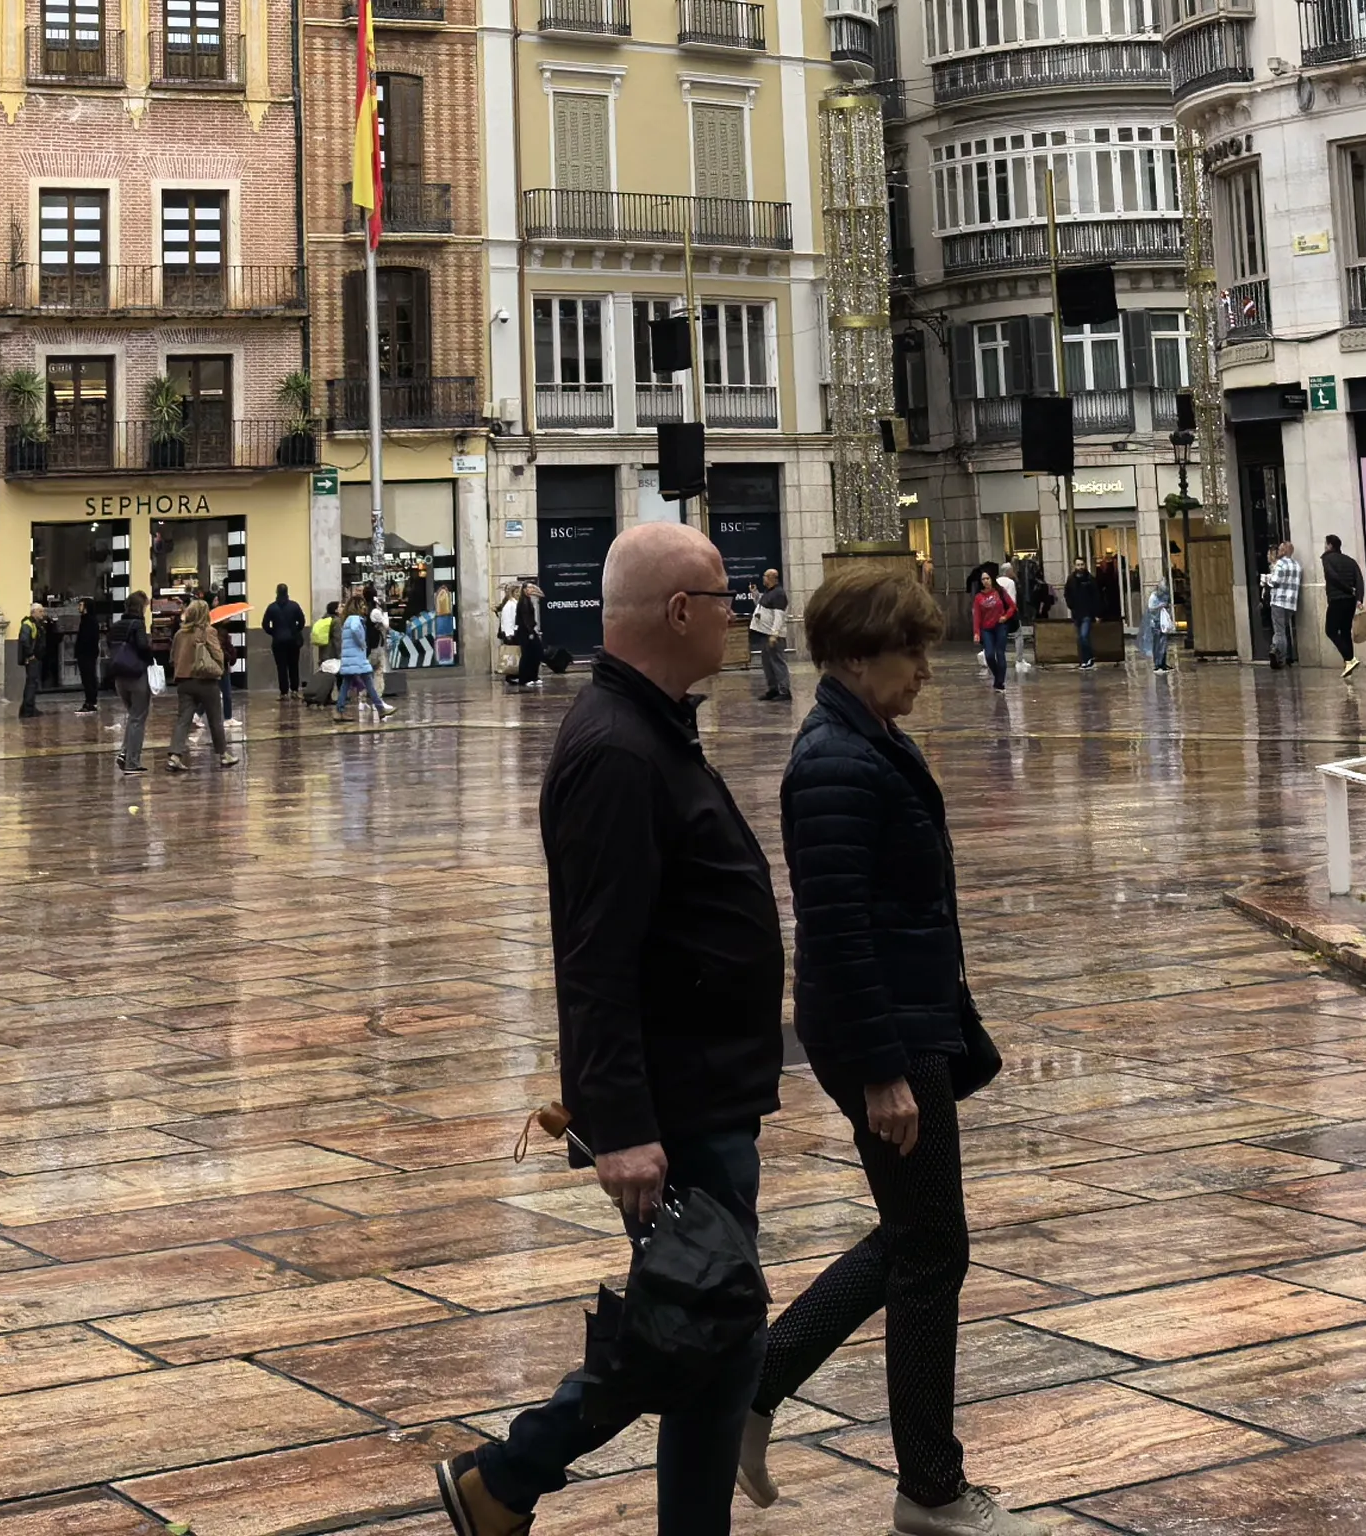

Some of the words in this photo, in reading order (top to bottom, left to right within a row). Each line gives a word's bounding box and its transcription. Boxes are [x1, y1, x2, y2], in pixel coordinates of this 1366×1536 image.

[1071, 479, 1124, 495] Desigual
[85, 495, 210, 516] SEPHORA
[550, 527, 573, 538] BSC
[720, 522, 742, 532] BSC
